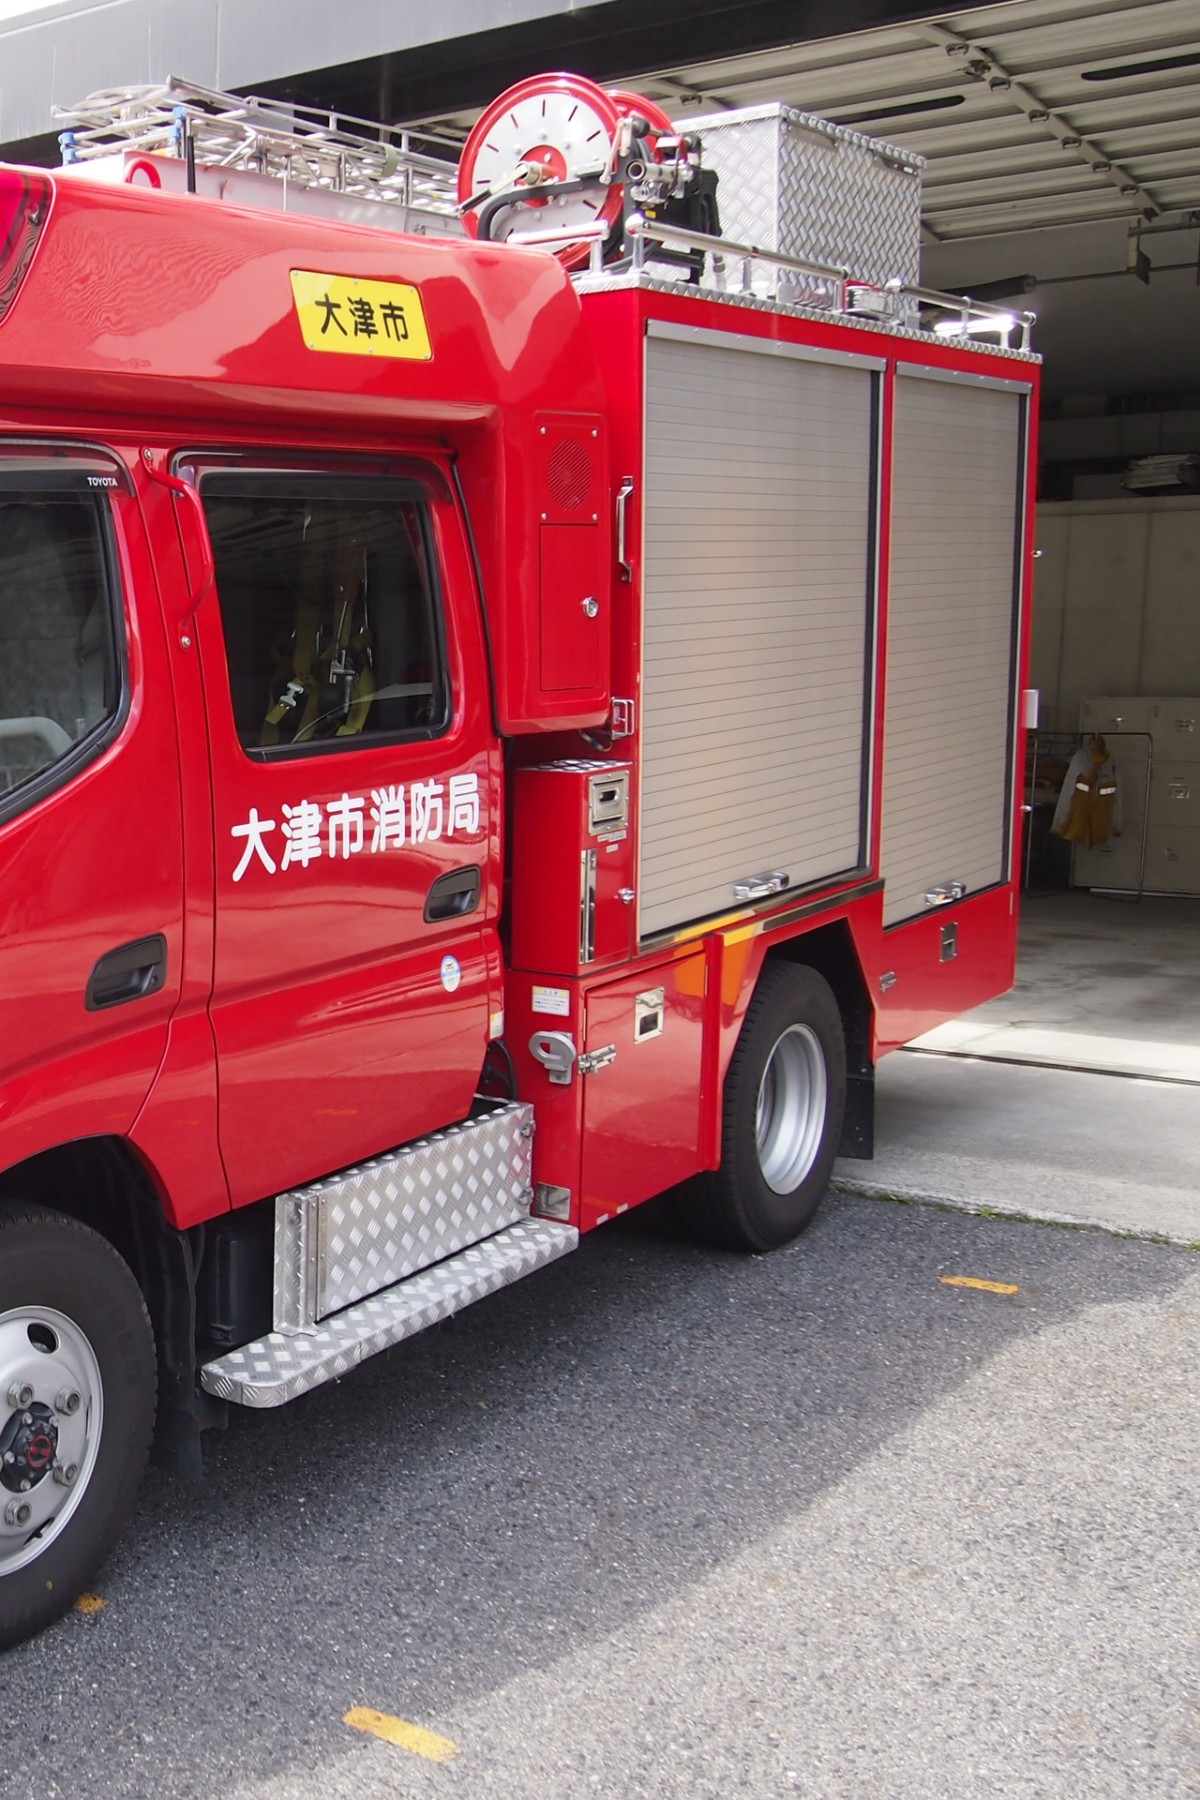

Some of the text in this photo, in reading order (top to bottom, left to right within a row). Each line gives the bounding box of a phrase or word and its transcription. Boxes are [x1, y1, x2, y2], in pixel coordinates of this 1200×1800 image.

[315, 292, 409, 342] 大津市
[87, 476, 118, 487] TOYOTA
[231, 773, 482, 882] 大津市消防局
